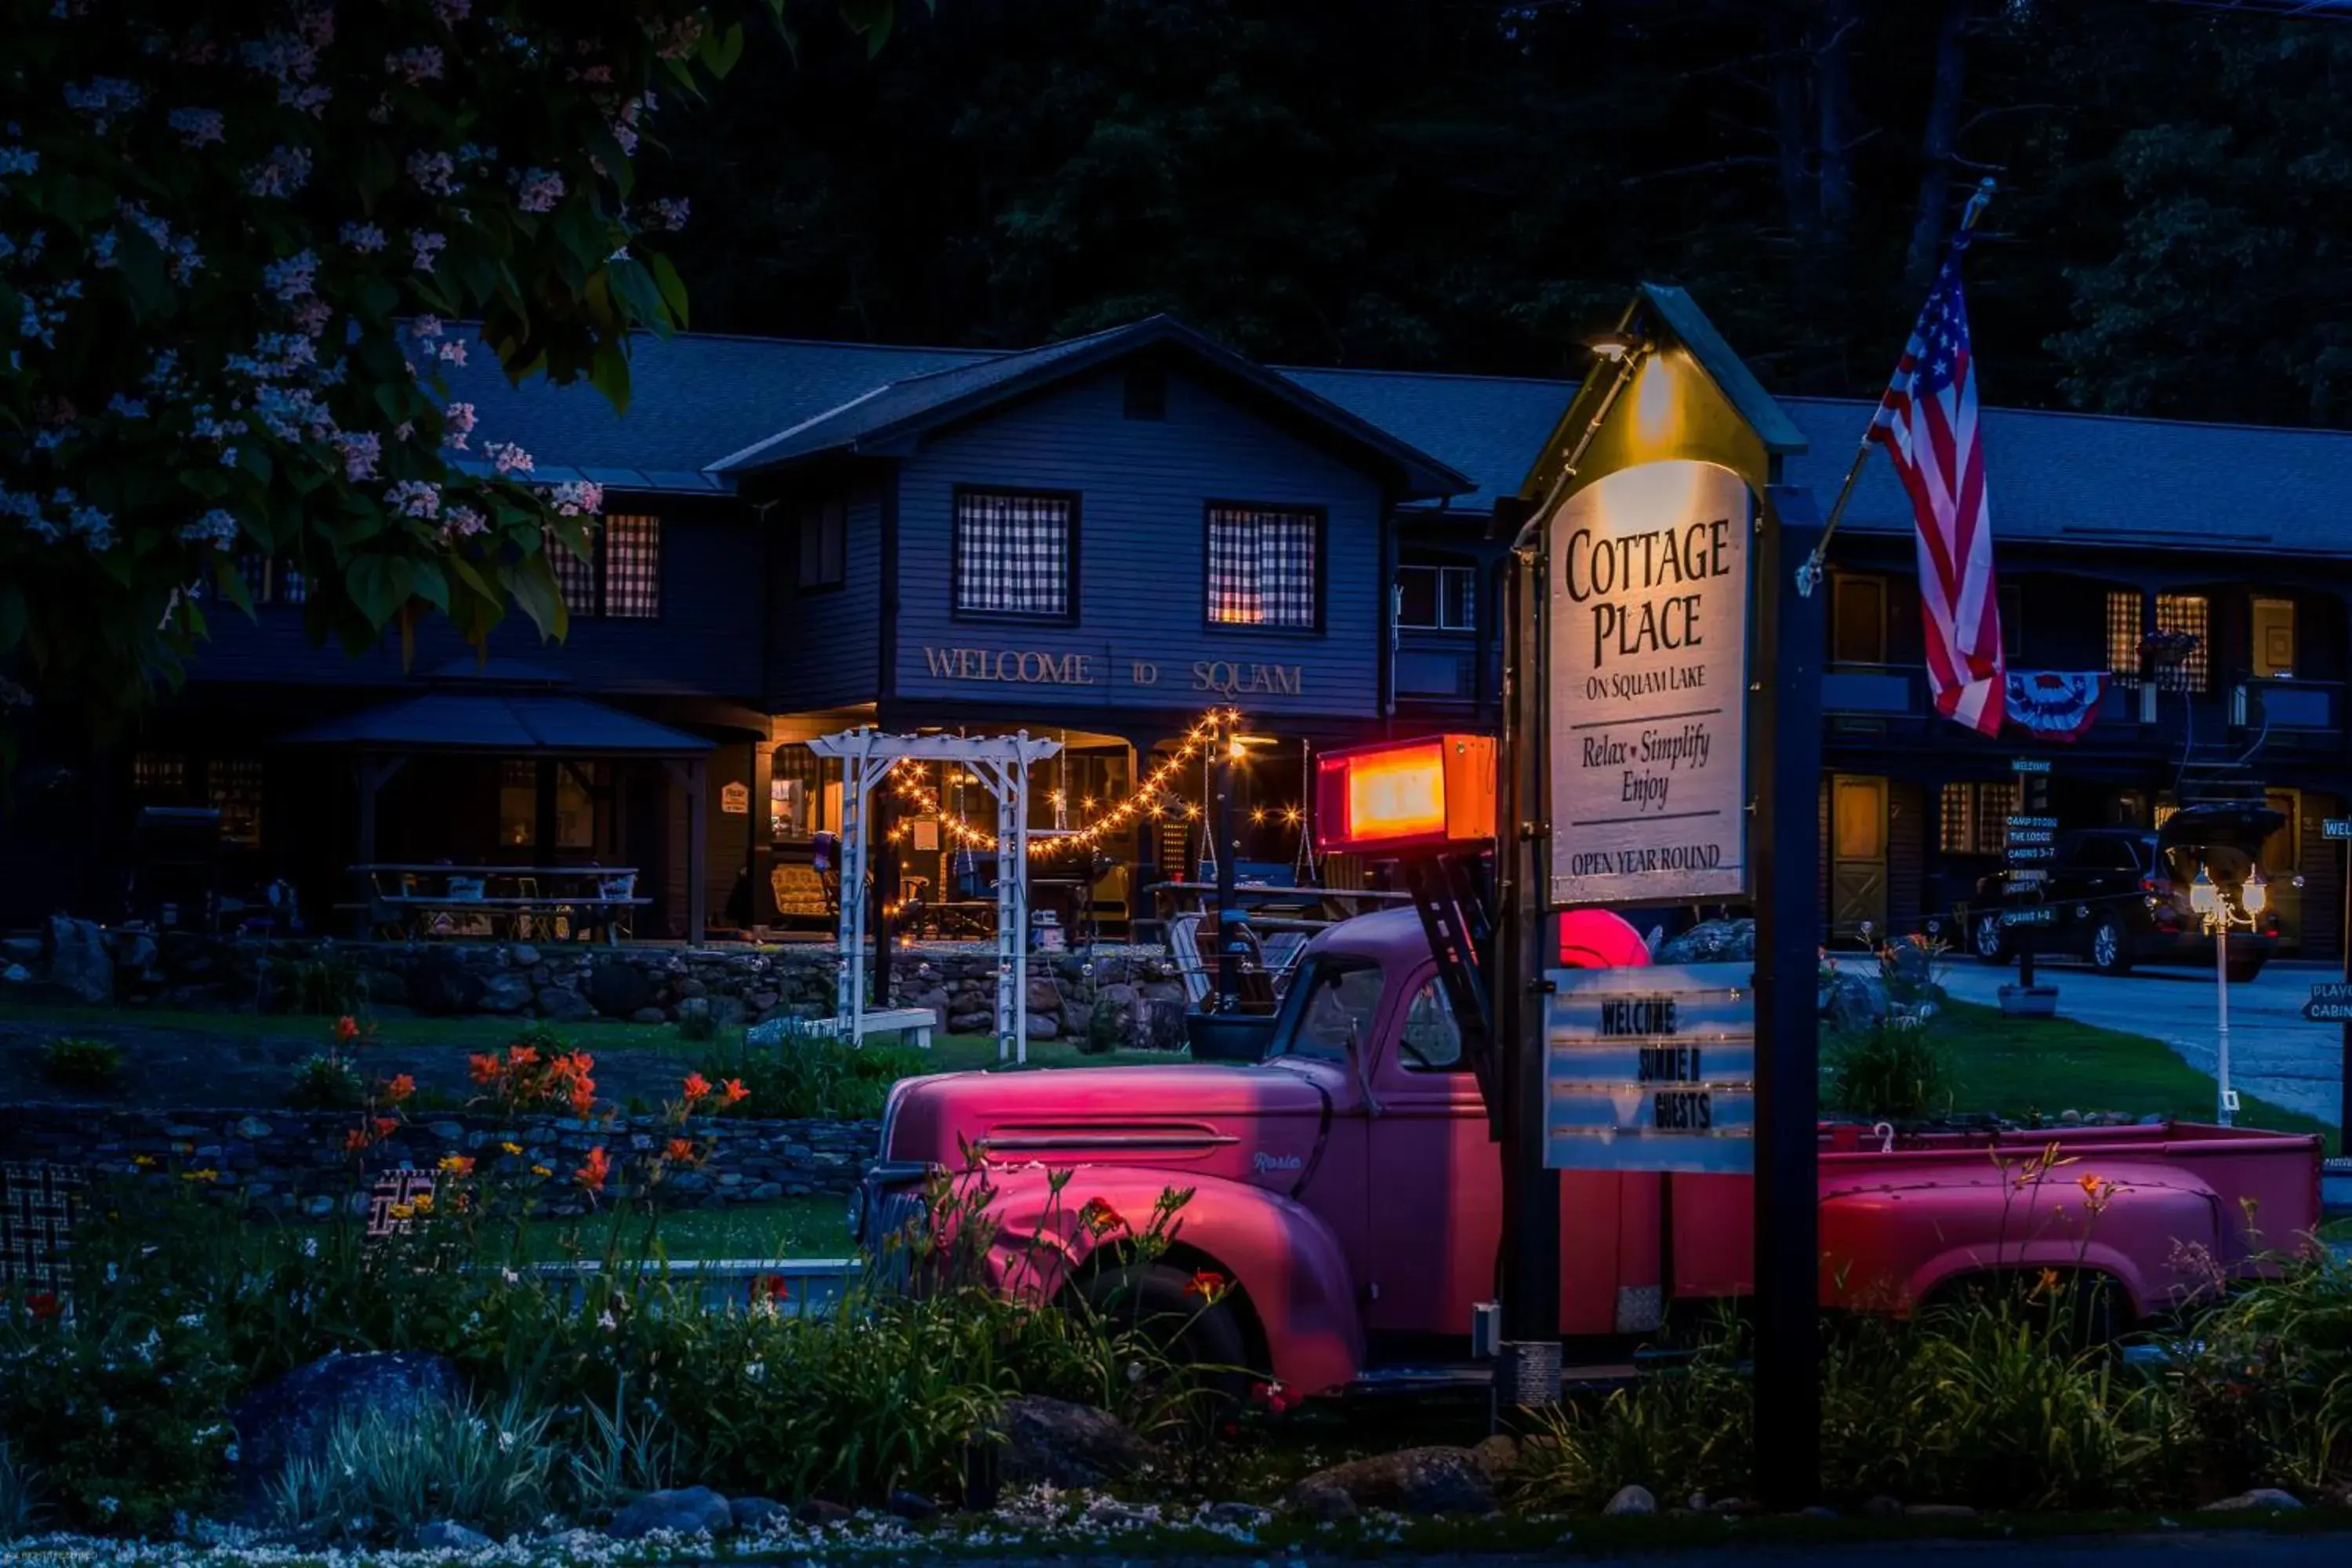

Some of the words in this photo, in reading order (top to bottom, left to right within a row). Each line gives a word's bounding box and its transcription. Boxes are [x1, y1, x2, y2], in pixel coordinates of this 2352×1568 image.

[1566, 520, 1730, 602] COTTAGE
[1592, 594, 1702, 669] PLACE
[924, 647, 1094, 684] WELCOME
[1192, 660, 1302, 700] SQUAM
[1587, 675, 1608, 700] ON
[1611, 669, 1666, 700] SQUAM
[1670, 665, 1706, 691] LAKE
[1582, 737, 1628, 768] Relax
[1641, 723, 1710, 773] Simplify
[1621, 771, 1669, 812] Enjoy
[1572, 851, 1614, 877] OPEN
[1617, 847, 1655, 873] YEAR
[1657, 844, 1720, 872] ROUND
[1603, 999, 1675, 1034] WELCOME
[1654, 1093, 1711, 1129] GUESTS
